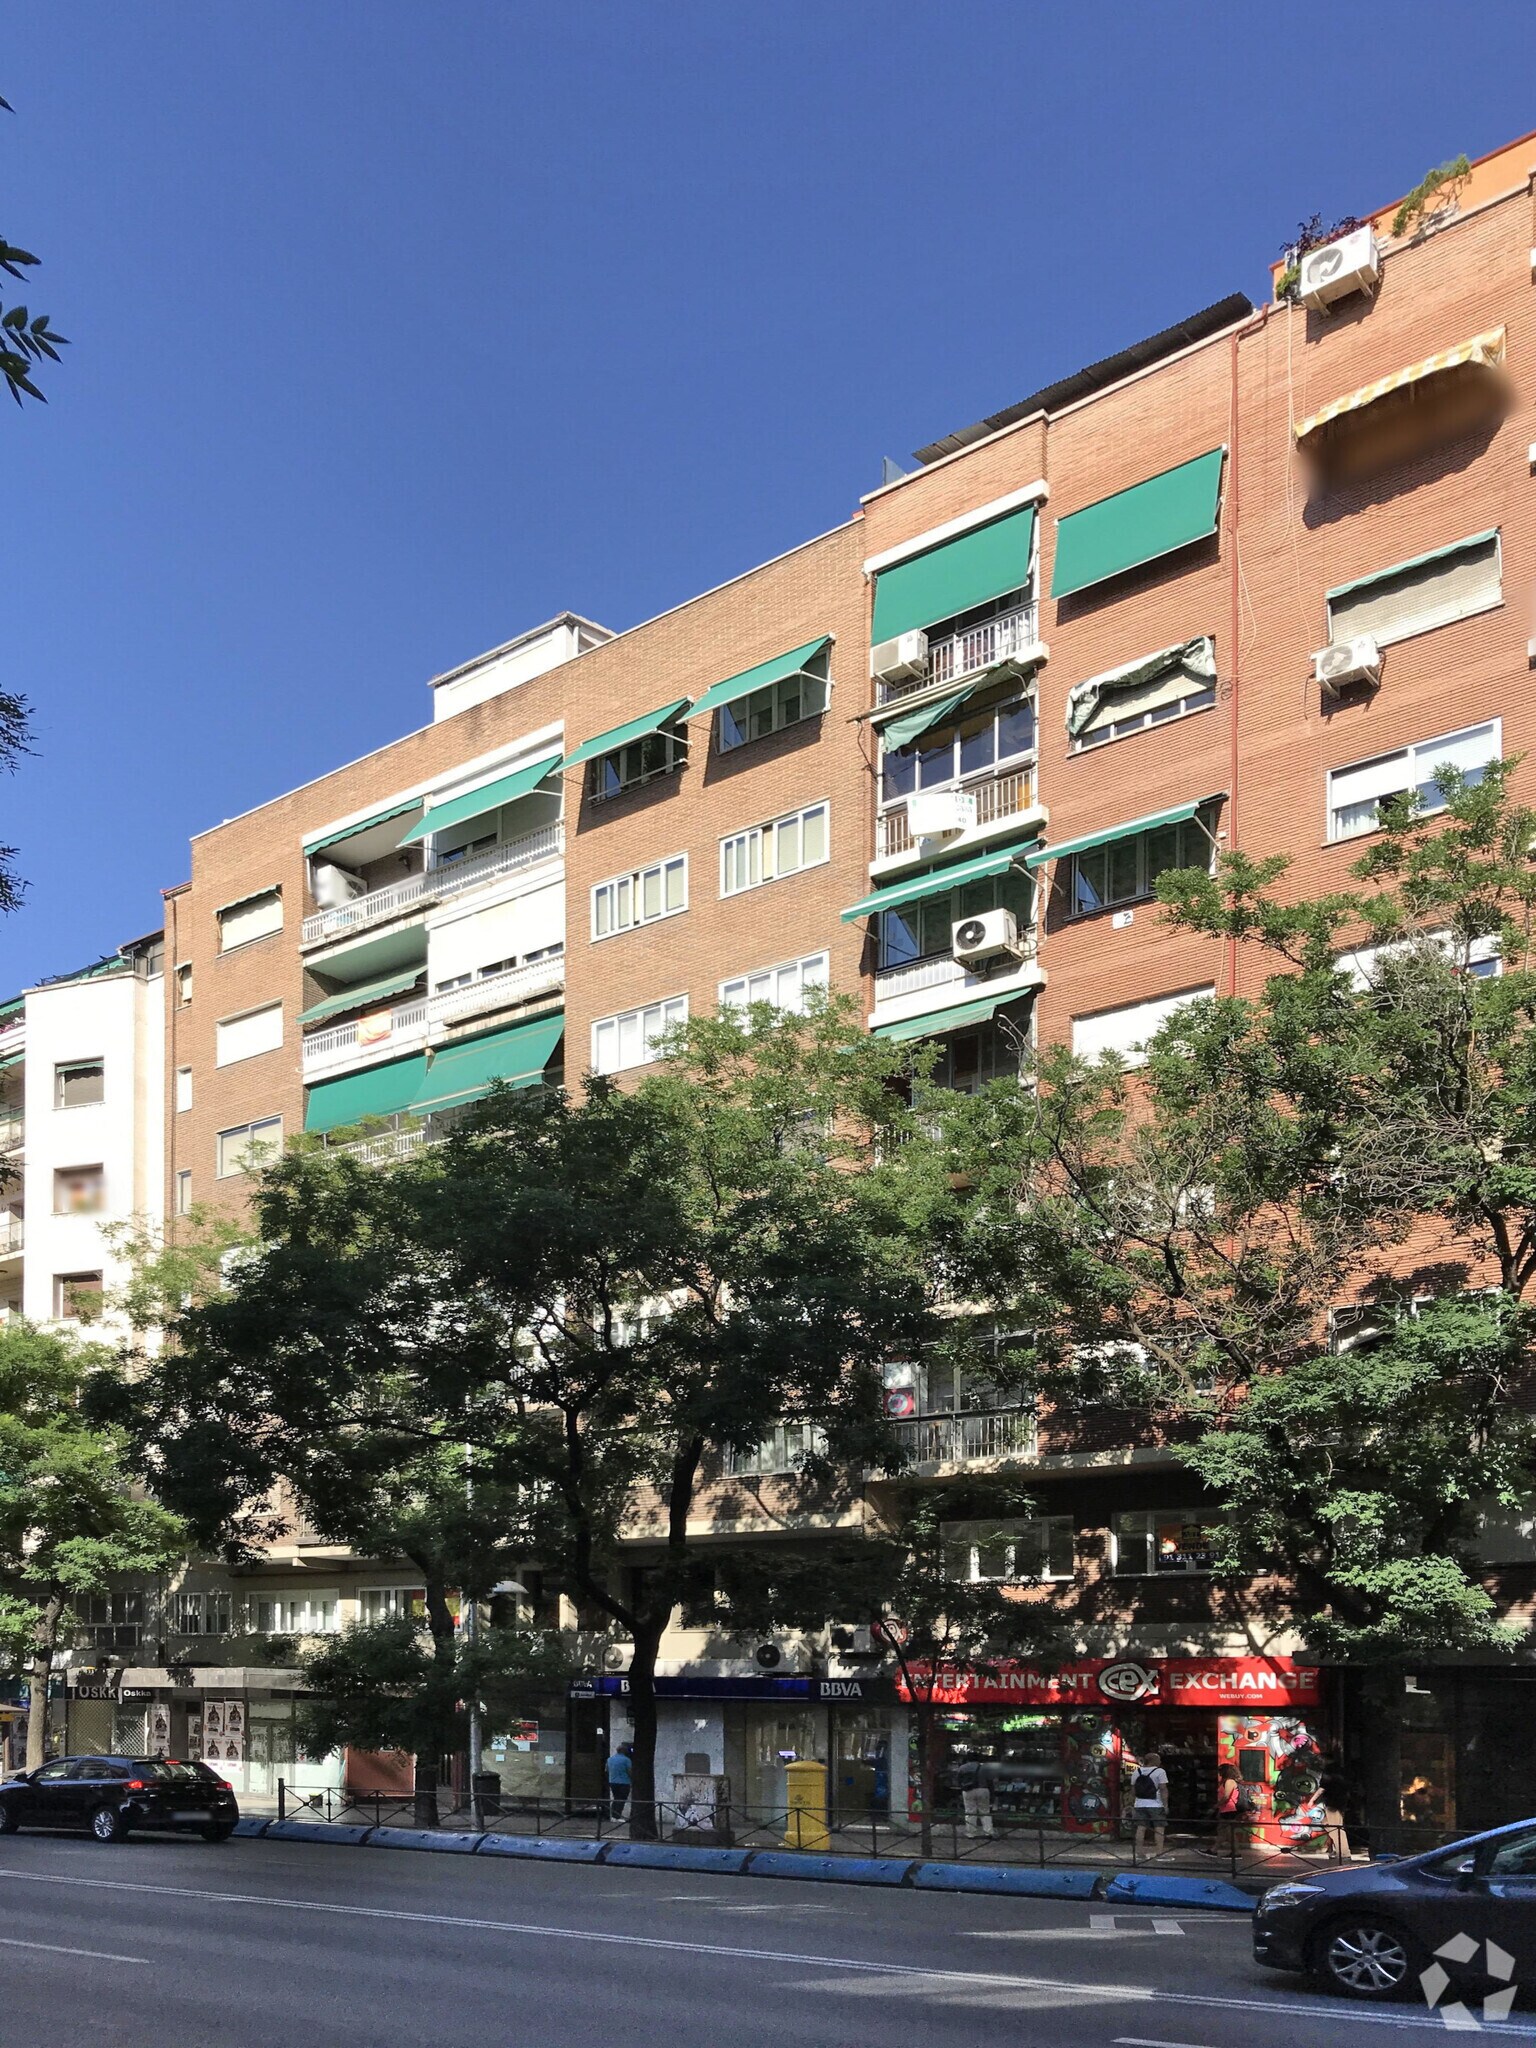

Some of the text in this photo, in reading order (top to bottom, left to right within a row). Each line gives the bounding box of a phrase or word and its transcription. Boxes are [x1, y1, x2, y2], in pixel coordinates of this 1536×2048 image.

[1196, 1552, 1207, 1560] 23
[1170, 1672, 1315, 1690] EXCHANGE
[820, 1682, 863, 1696] BBVA
